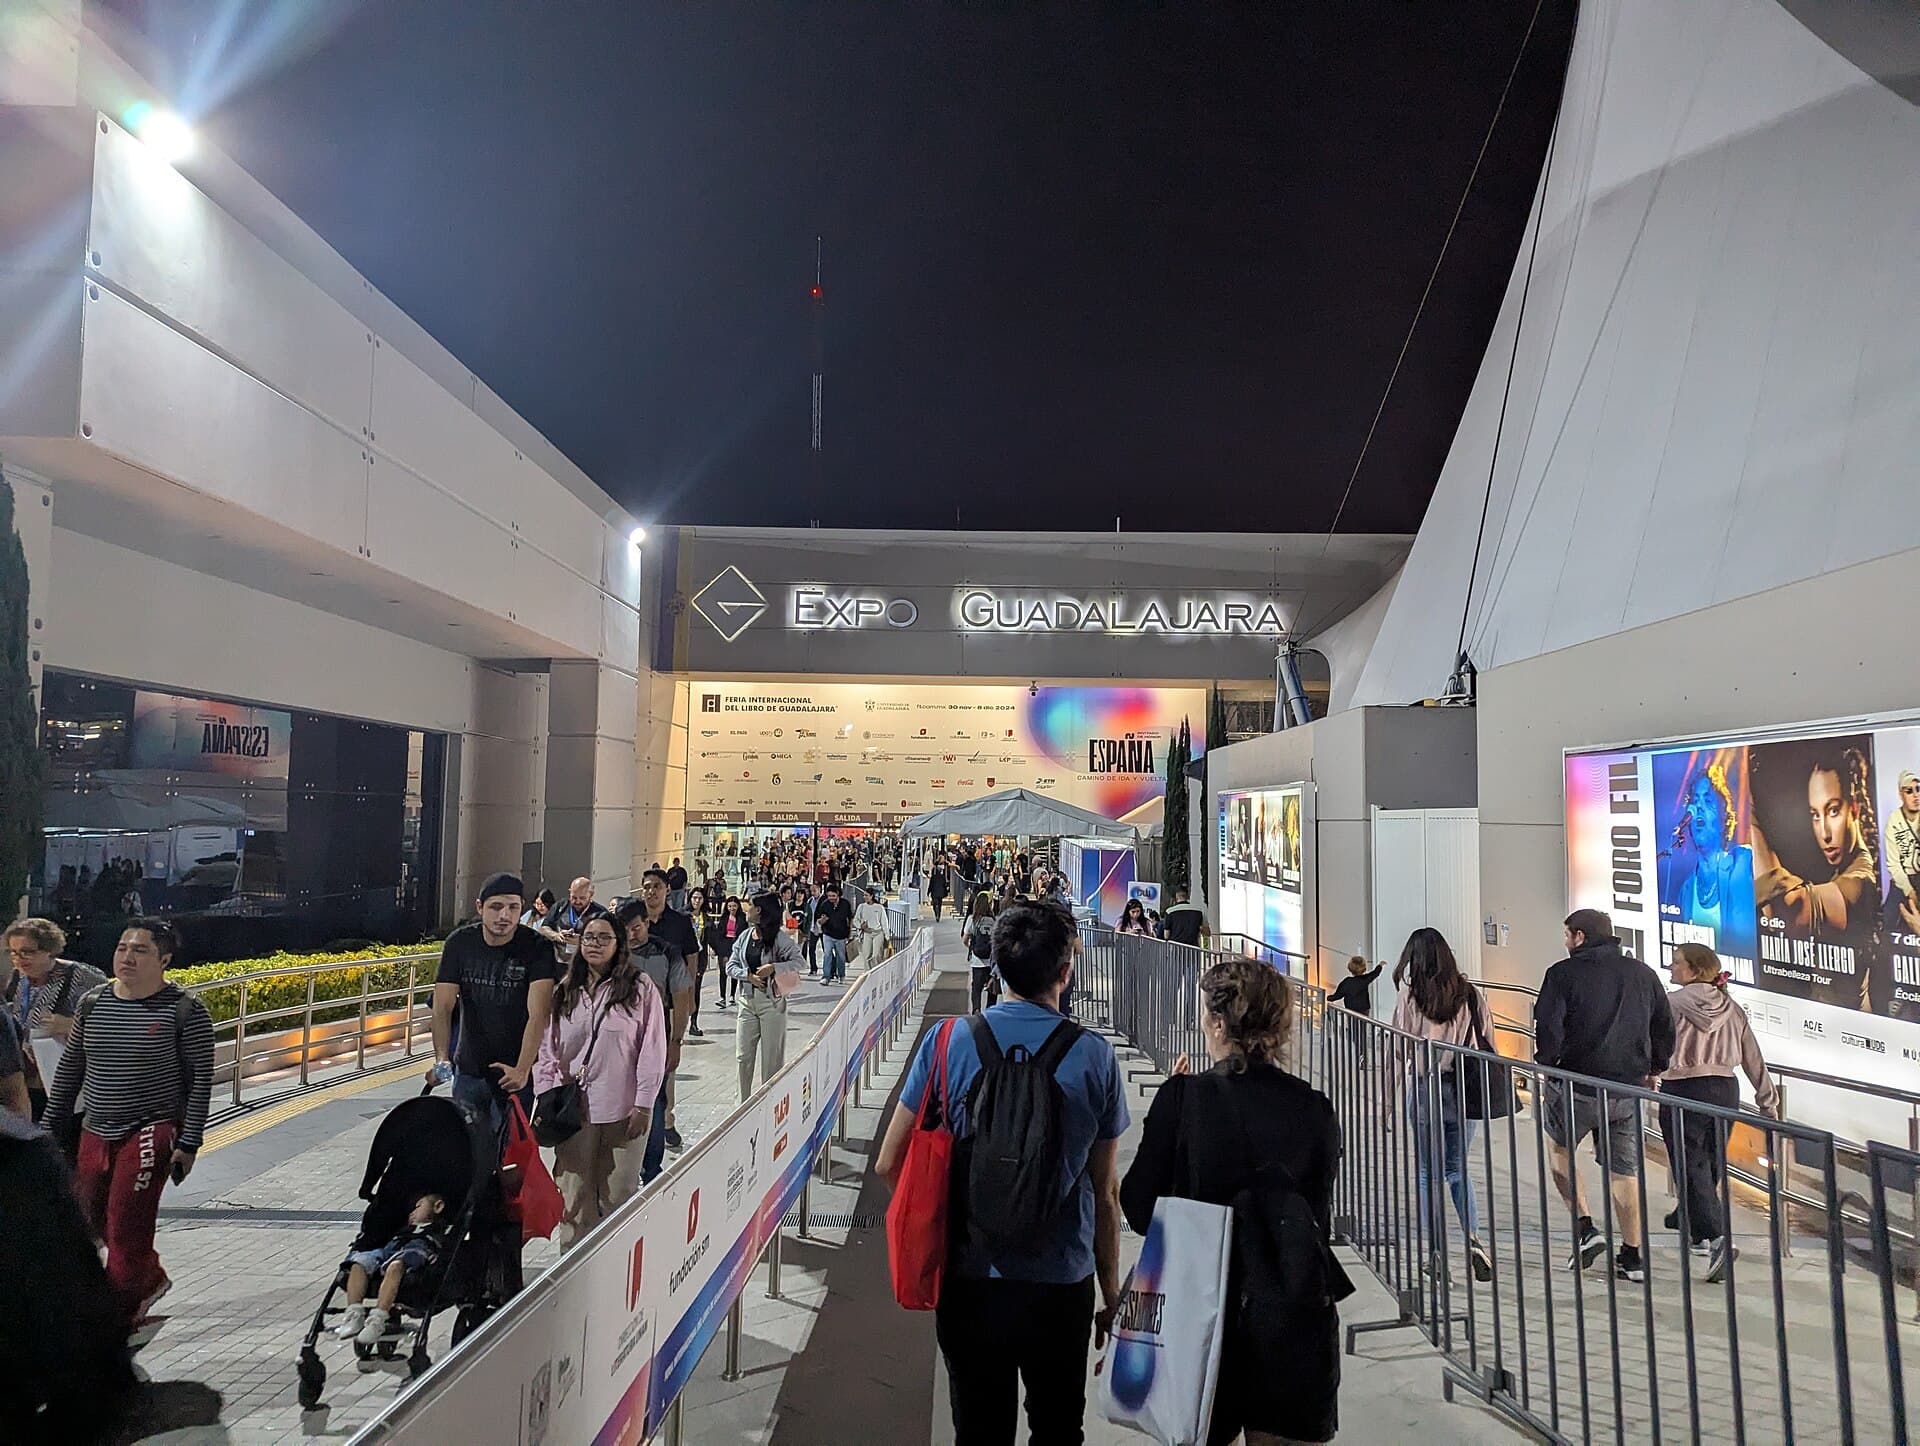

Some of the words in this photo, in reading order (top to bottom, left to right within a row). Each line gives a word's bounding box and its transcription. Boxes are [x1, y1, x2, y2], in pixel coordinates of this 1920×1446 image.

[795, 586, 919, 629] EXPO
[959, 589, 1286, 636] GUADALAJARA
[749, 696, 812, 704] INTERNACIONAL
[725, 704, 739, 712] DEL
[778, 705, 836, 713] GUADALAJARA
[1089, 732, 1155, 774] ESPAÑA
[1607, 755, 1640, 814] FIL
[702, 813, 729, 821] SALIDA
[834, 814, 861, 822] SALIDA
[1611, 825, 1643, 913] FORO
[1759, 916, 1769, 927] 6
[1769, 917, 1786, 929] dic
[1891, 932, 1900, 945] 7
[1760, 931, 1791, 964] MARÍA
[1793, 936, 1817, 968] JOSÉ
[1818, 943, 1856, 975] LLERGO
[1763, 964, 1811, 982] Ultrabelleza
[1811, 973, 1833, 985] Tour
[1803, 1019, 1824, 1032] AC/E
[1841, 1034, 1866, 1049] cultura
[667, 1241, 701, 1297] fundación
